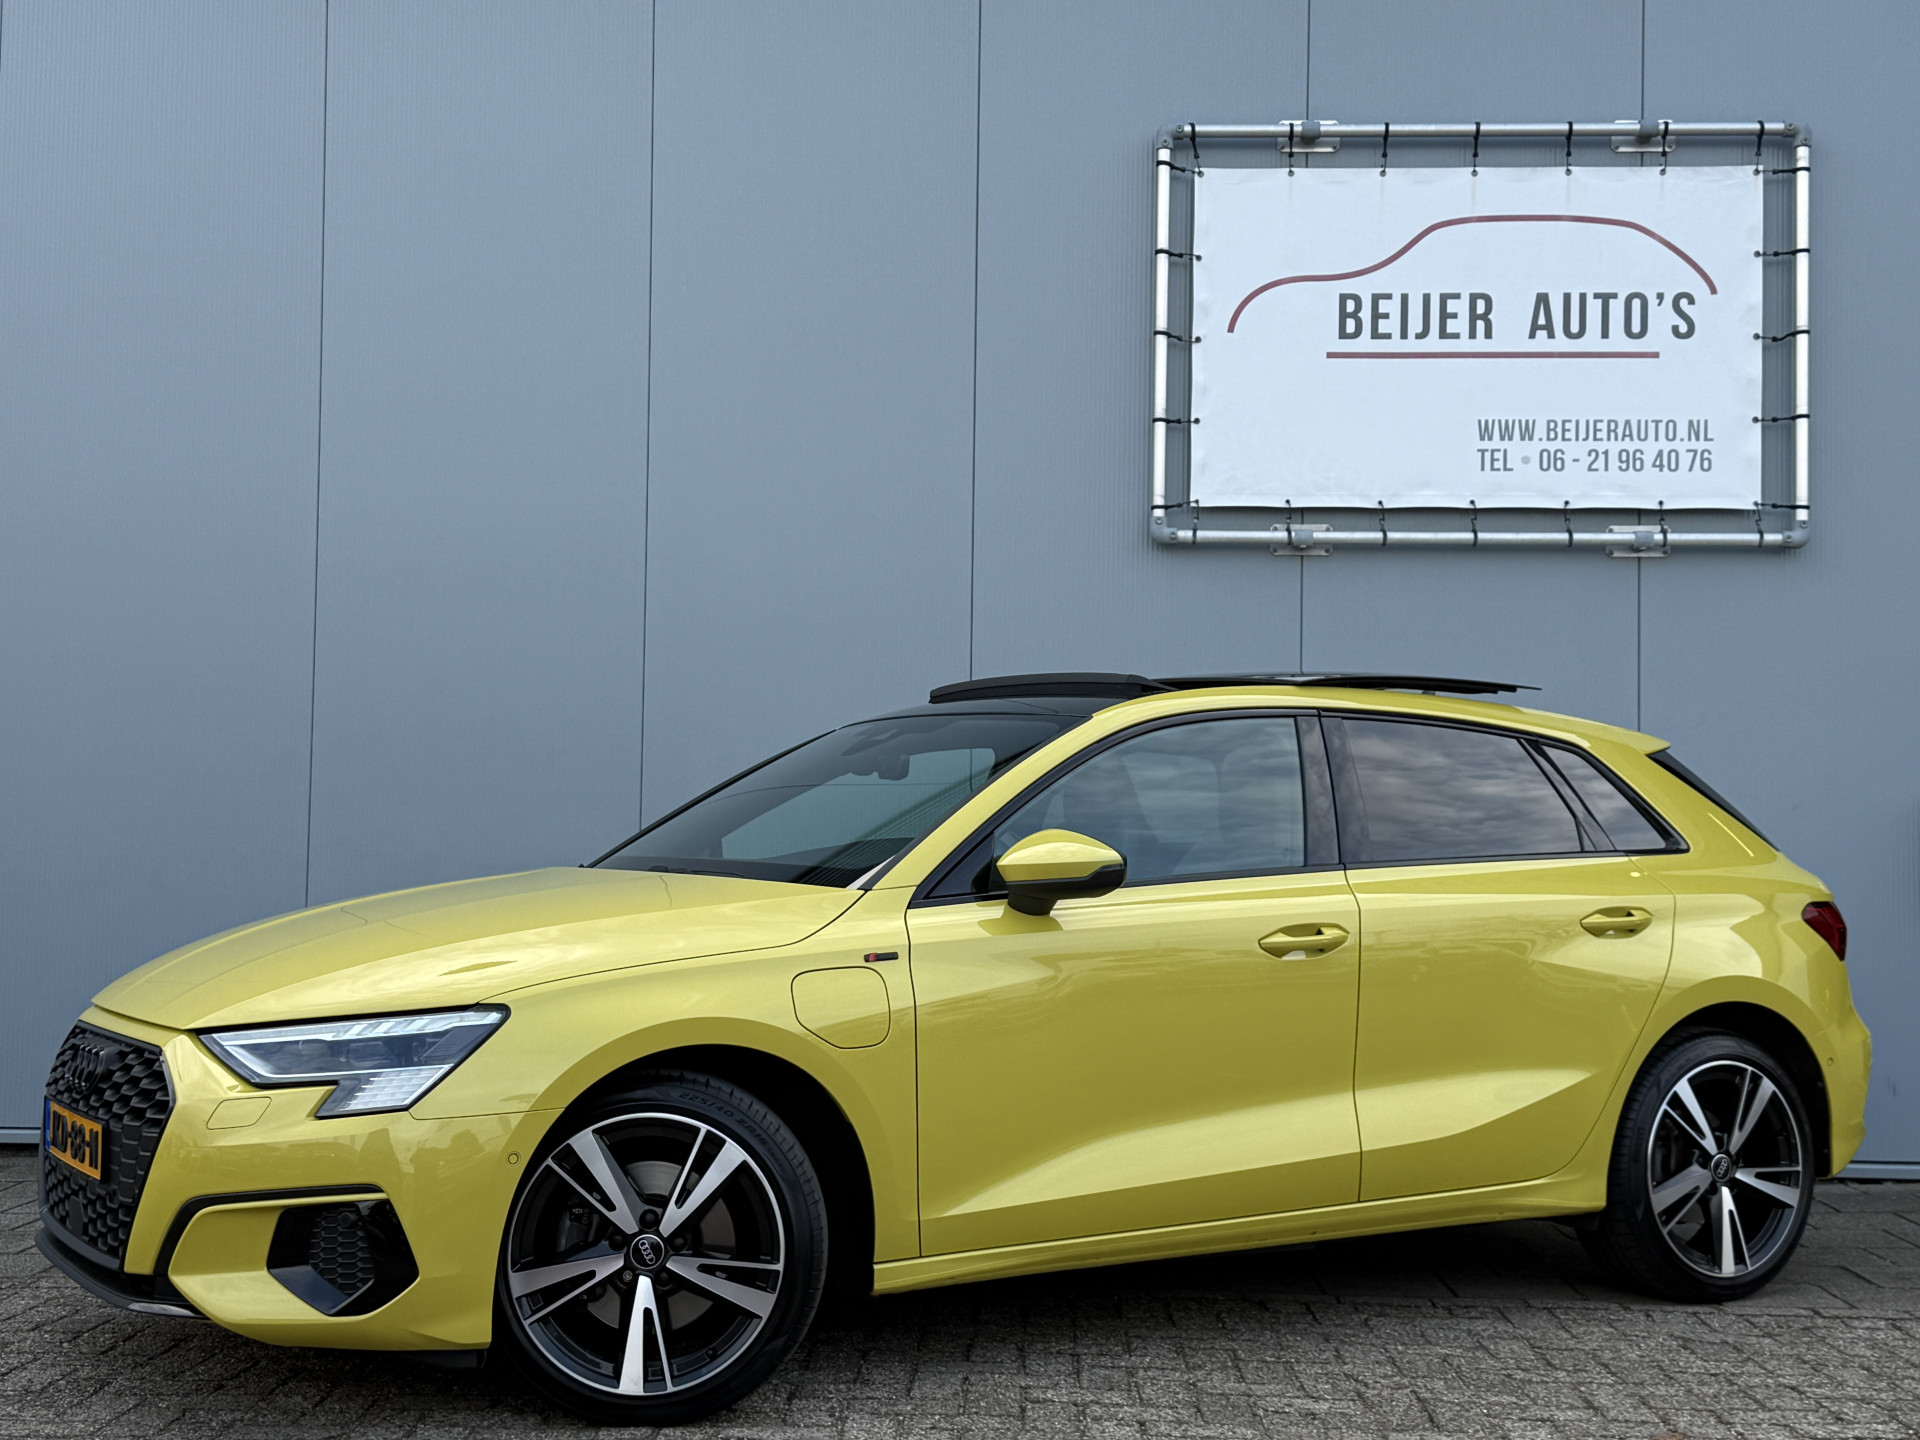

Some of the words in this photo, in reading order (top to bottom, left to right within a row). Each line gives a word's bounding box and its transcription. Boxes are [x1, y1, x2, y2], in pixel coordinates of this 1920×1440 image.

[1337, 292, 1494, 340] BEIJER
[1528, 291, 1697, 340] AUTO'S
[1477, 418, 1715, 442] WWW.BEIJERAUTO.NL
[1477, 448, 1514, 472] TEL
[1538, 448, 1566, 472] 06
[1587, 448, 1610, 472] 21
[1617, 448, 1645, 472] 96
[1651, 448, 1680, 472] 40
[1685, 448, 1713, 472] 76
